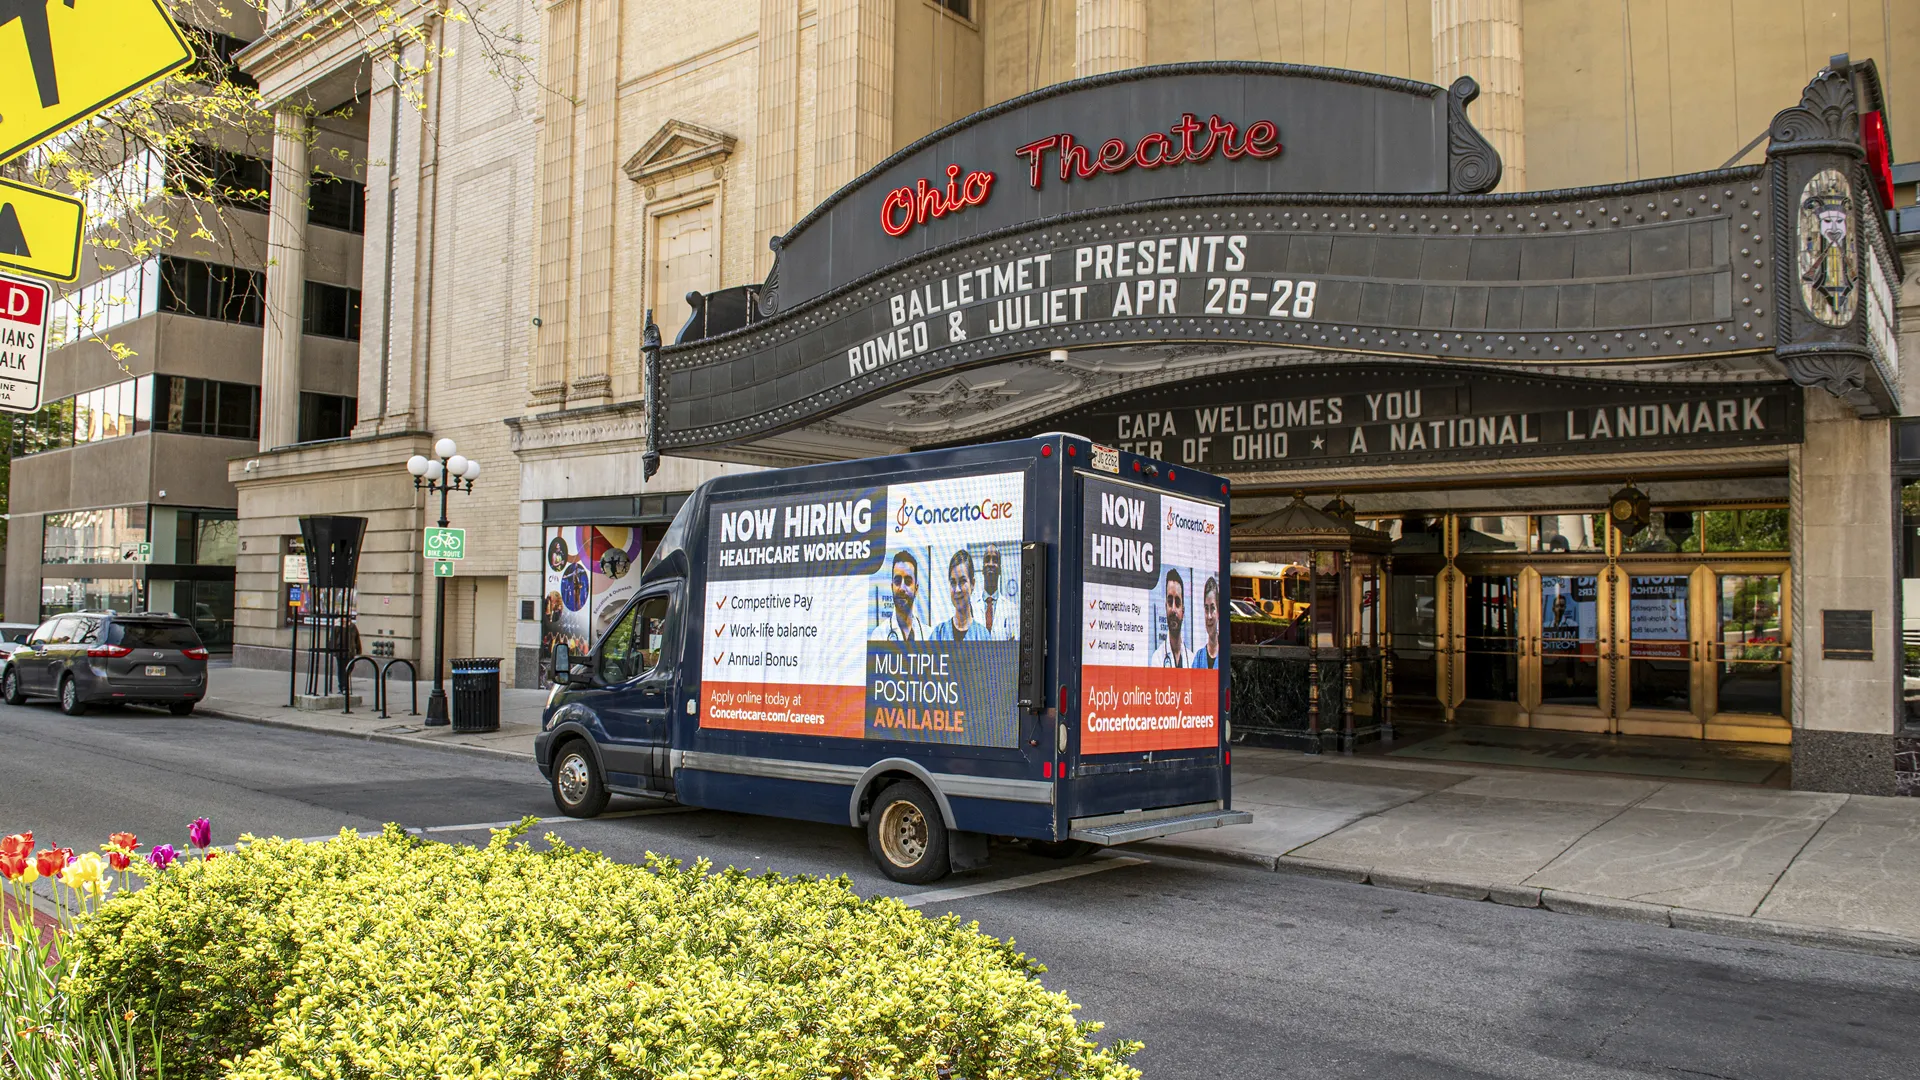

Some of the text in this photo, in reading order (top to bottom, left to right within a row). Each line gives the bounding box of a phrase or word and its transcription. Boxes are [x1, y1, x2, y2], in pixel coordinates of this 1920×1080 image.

[880, 113, 1282, 236] Ohio Theatre
[890, 235, 1247, 327] BALLETMET PRESENTS
[848, 277, 1316, 377] ROMEO & JULIET APR 26-28
[1118, 389, 1422, 439] CAPA WELCOMES YOU
[1108, 397, 1765, 464] TER OF OHIO A NATIONAL LANDMARK
[721, 499, 872, 543] NOW HIRING
[915, 499, 1012, 525] ConcertoCare
[1101, 492, 1145, 530] NOW
[1175, 513, 1214, 535] ConcertoCare
[719, 540, 871, 567] HEALTHCARE WORKERS
[1092, 534, 1153, 573] HIRING
[731, 595, 813, 613] Competitive Pay
[1099, 600, 1141, 616] Competitive Pay
[730, 624, 817, 638] Work-life balance
[1099, 620, 1143, 633] Work-life balance
[1098, 640, 1134, 651] Annual Bonus
[728, 652, 798, 667] Annual Bonus
[875, 654, 949, 676] MULTIPLE
[711, 690, 801, 708] Apply online today at
[875, 681, 958, 704] POSITIONS
[1088, 686, 1192, 711] Apply online today at
[710, 705, 824, 724] Concertocare.com/careers
[874, 708, 964, 732] AVAILABLE
[1088, 712, 1214, 732] Concertocare.com/careers
